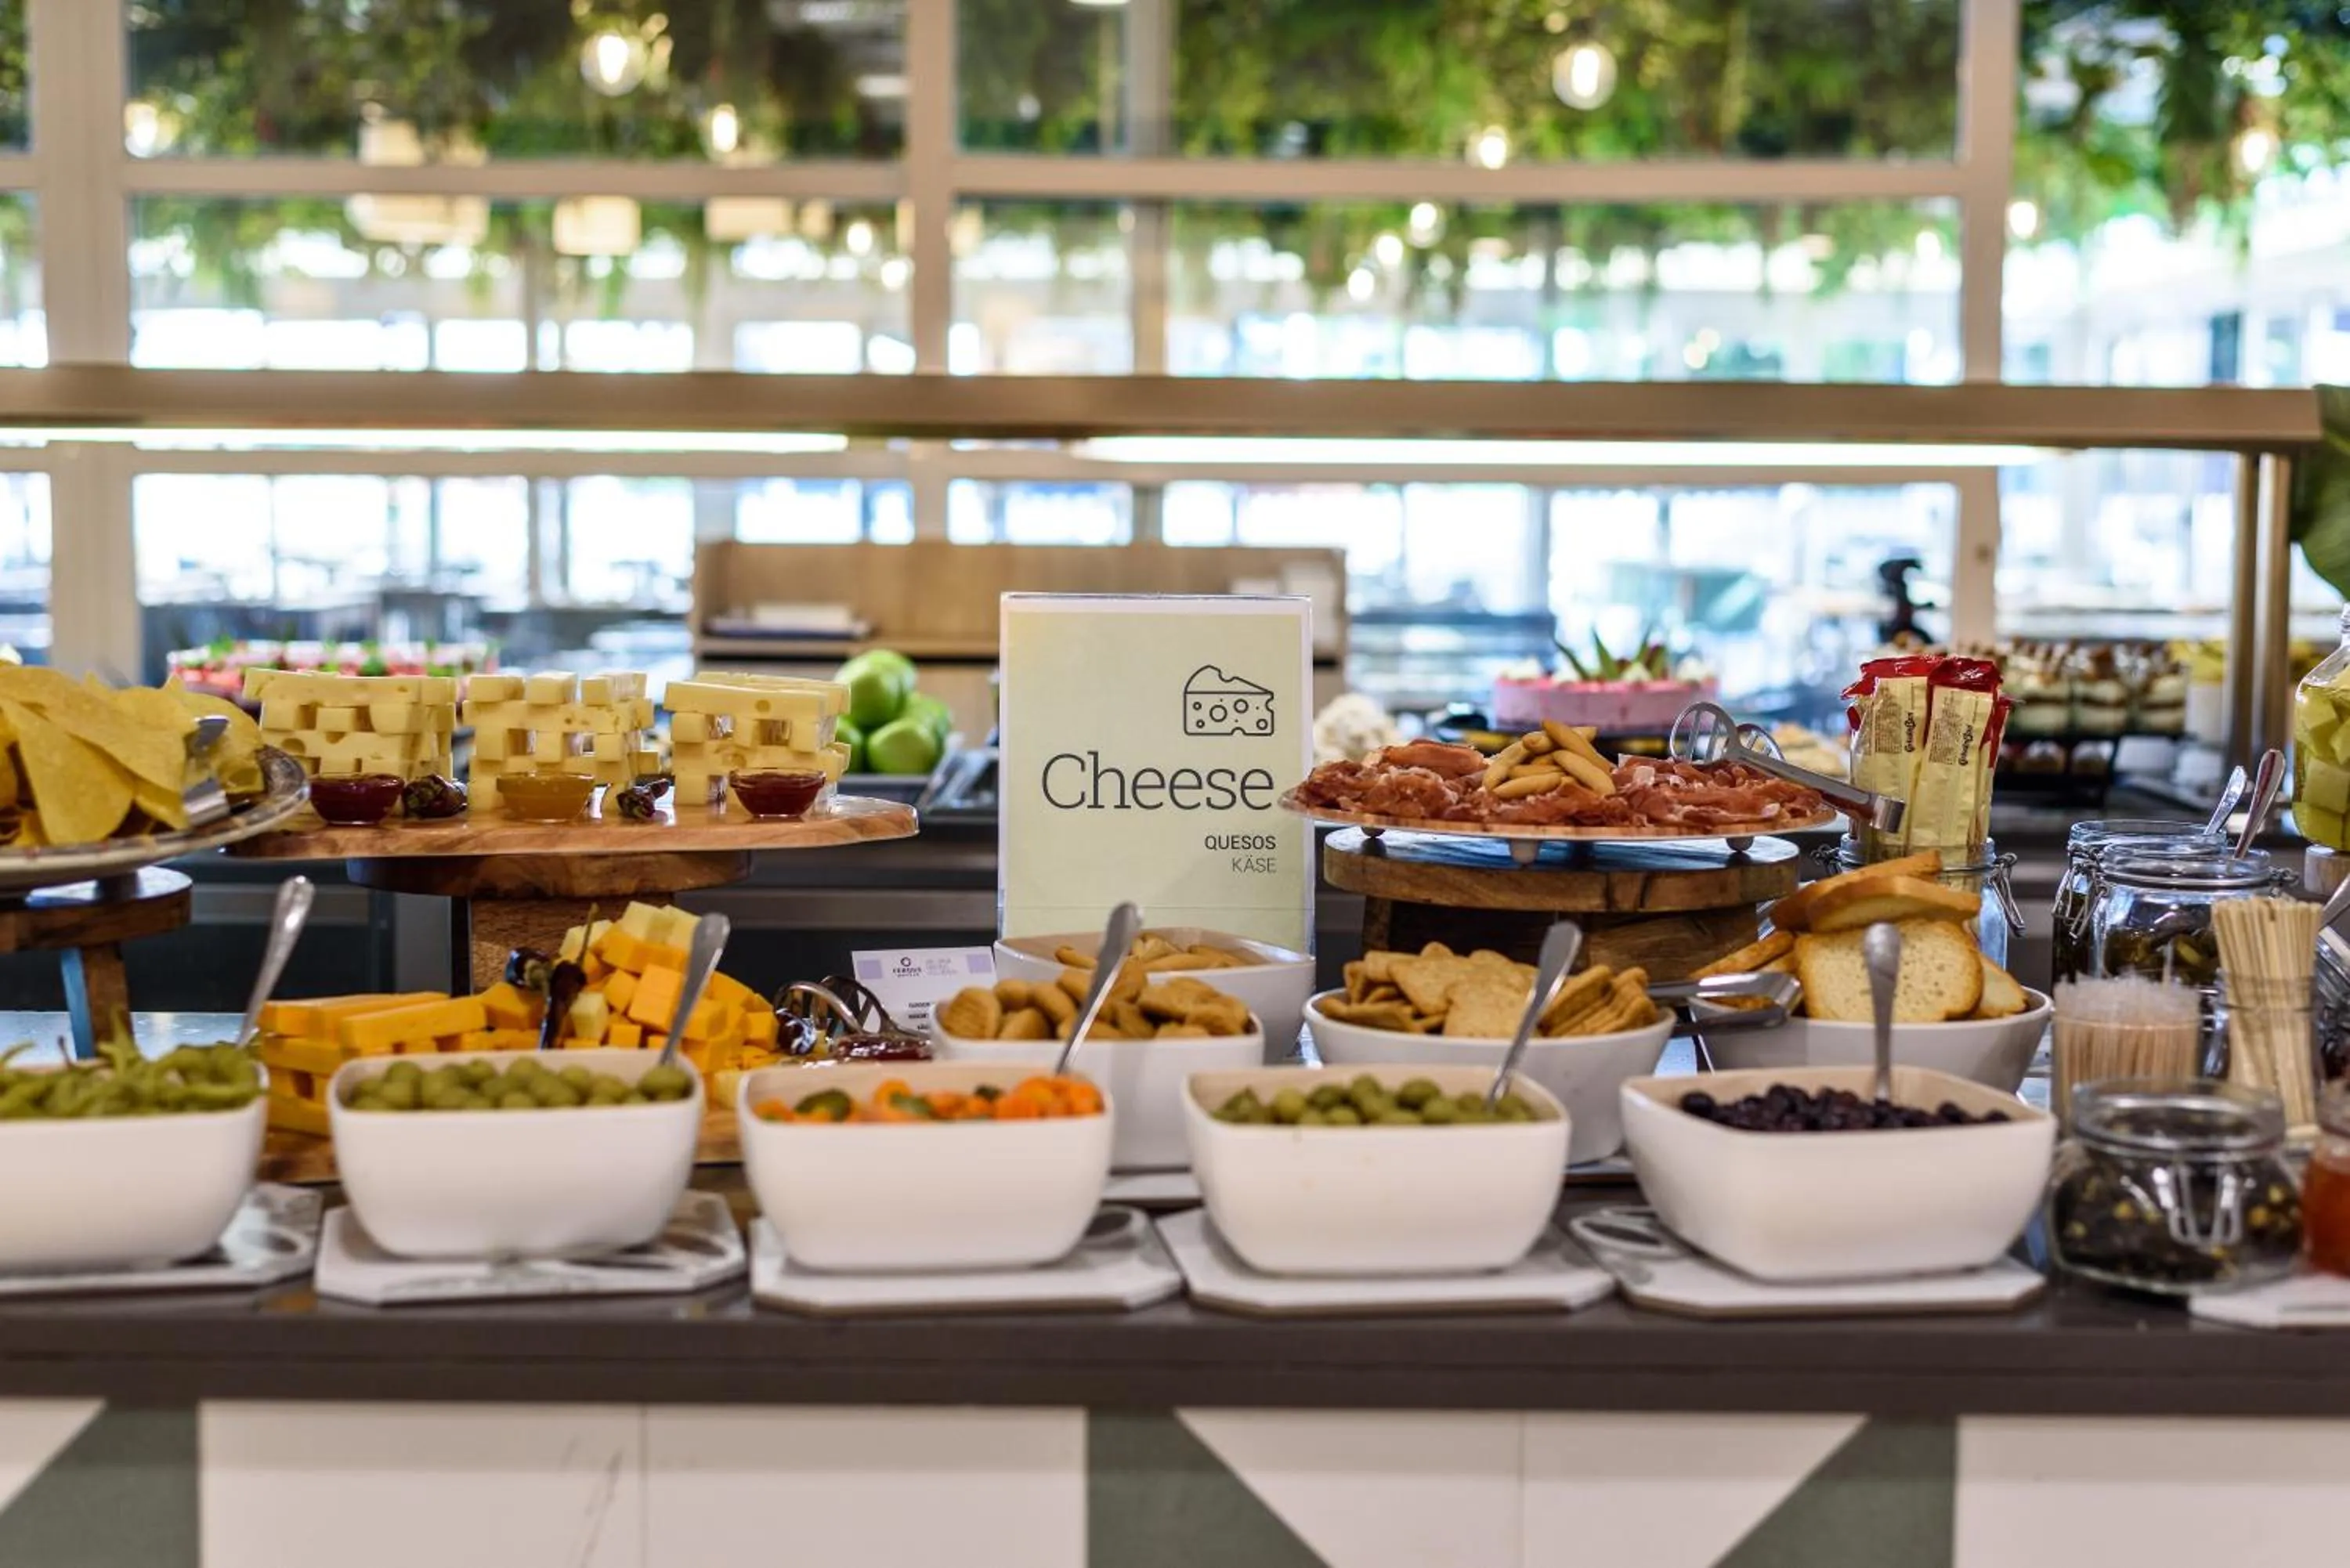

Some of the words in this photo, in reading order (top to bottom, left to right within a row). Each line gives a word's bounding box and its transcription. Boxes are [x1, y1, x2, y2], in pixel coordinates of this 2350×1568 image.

[1042, 750, 1274, 811] Cheese
[1204, 835, 1276, 851] QUESOS
[1231, 854, 1277, 873] KÄSE
